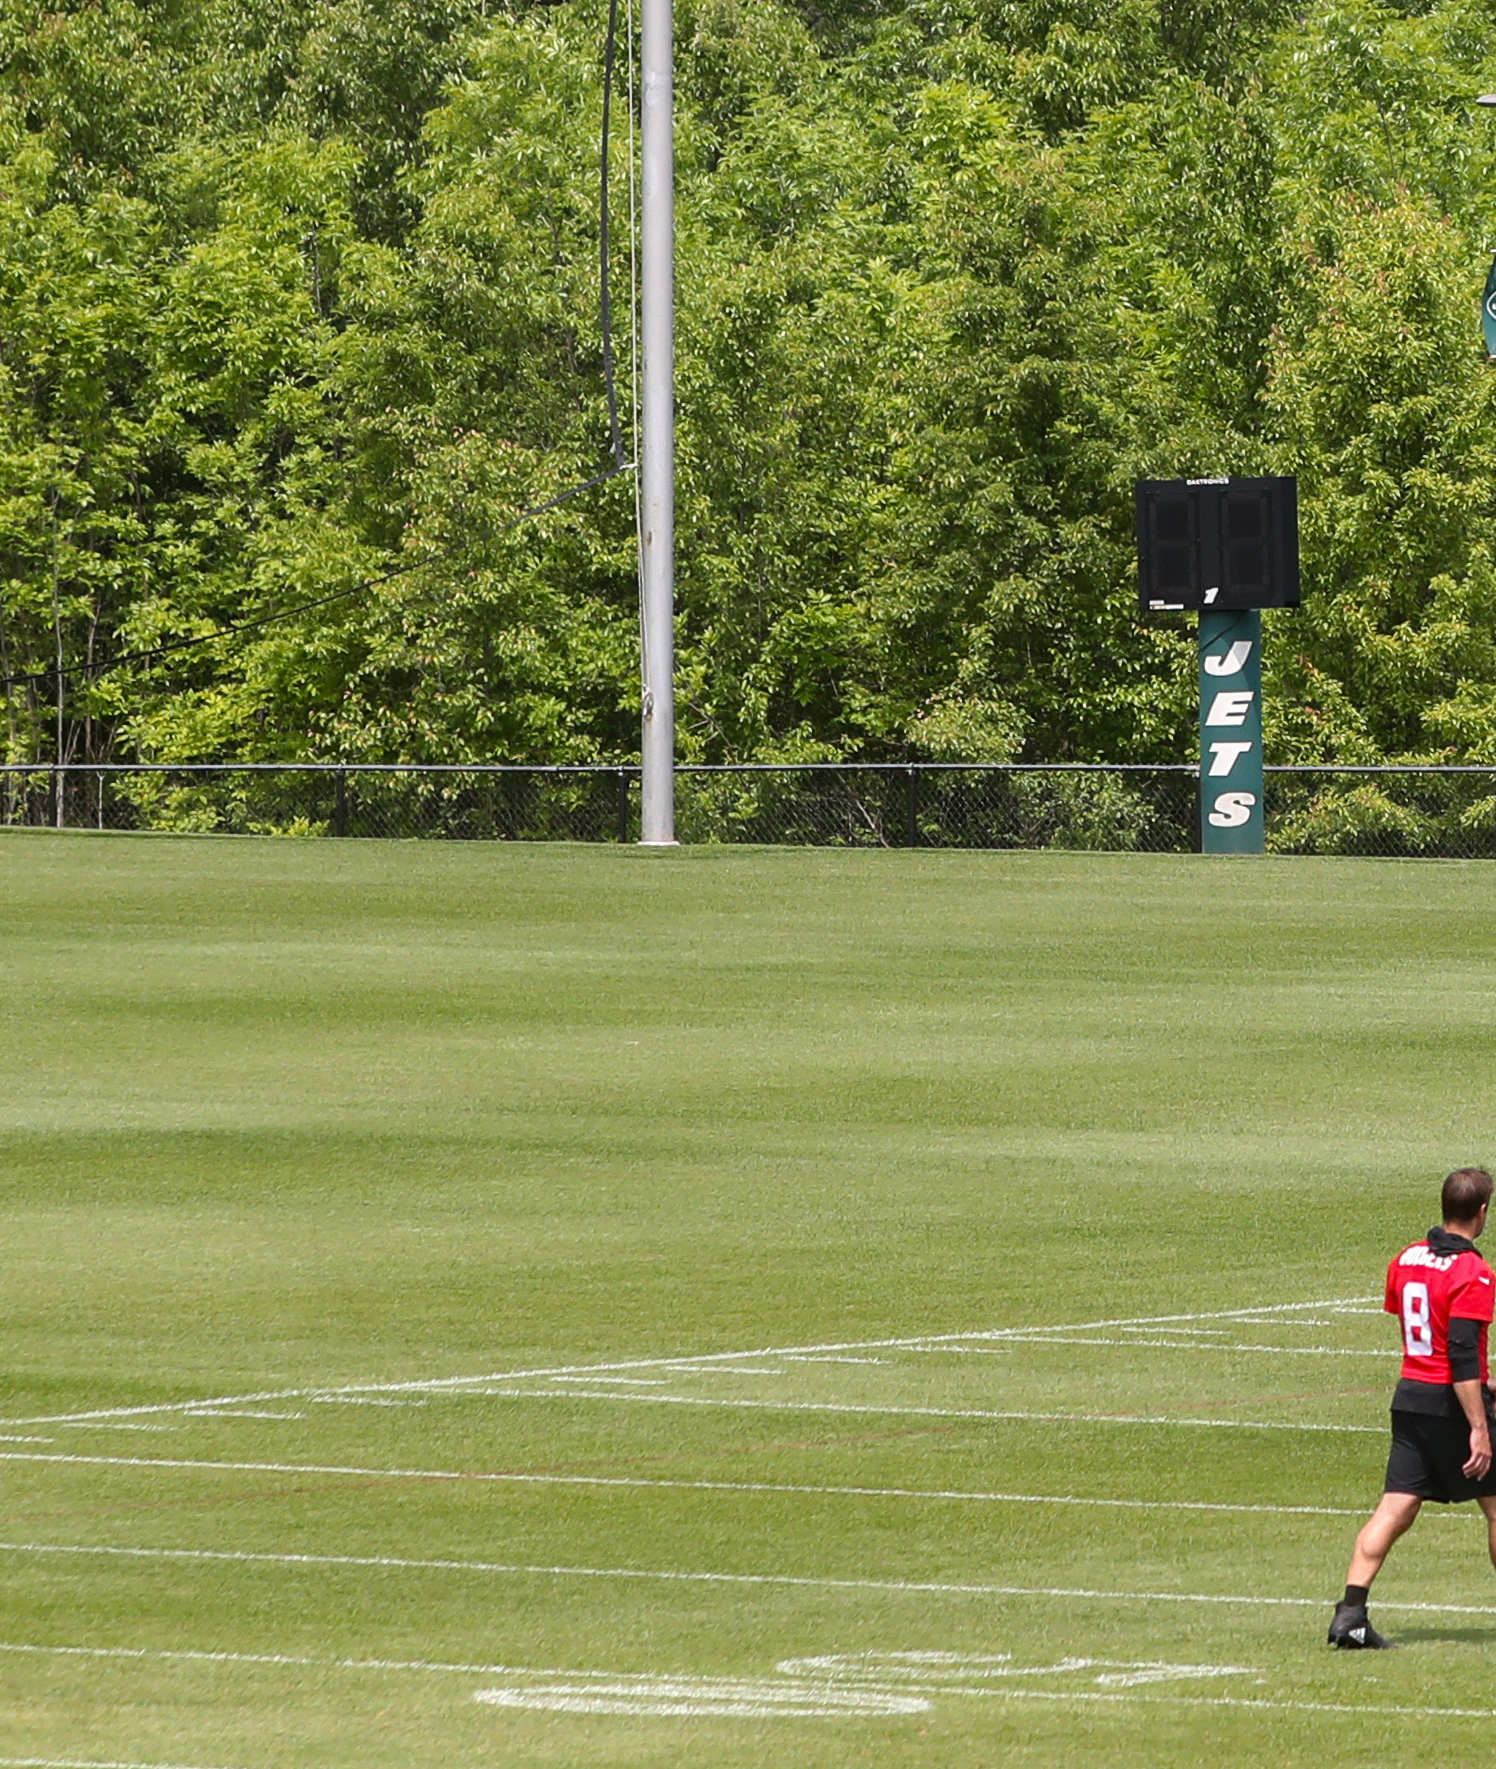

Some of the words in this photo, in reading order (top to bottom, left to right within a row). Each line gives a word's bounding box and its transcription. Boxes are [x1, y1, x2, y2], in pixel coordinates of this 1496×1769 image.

[1203, 587, 1219, 604] 1
[1204, 641, 1256, 827] JETS
[1402, 1282, 1434, 1357] 8
